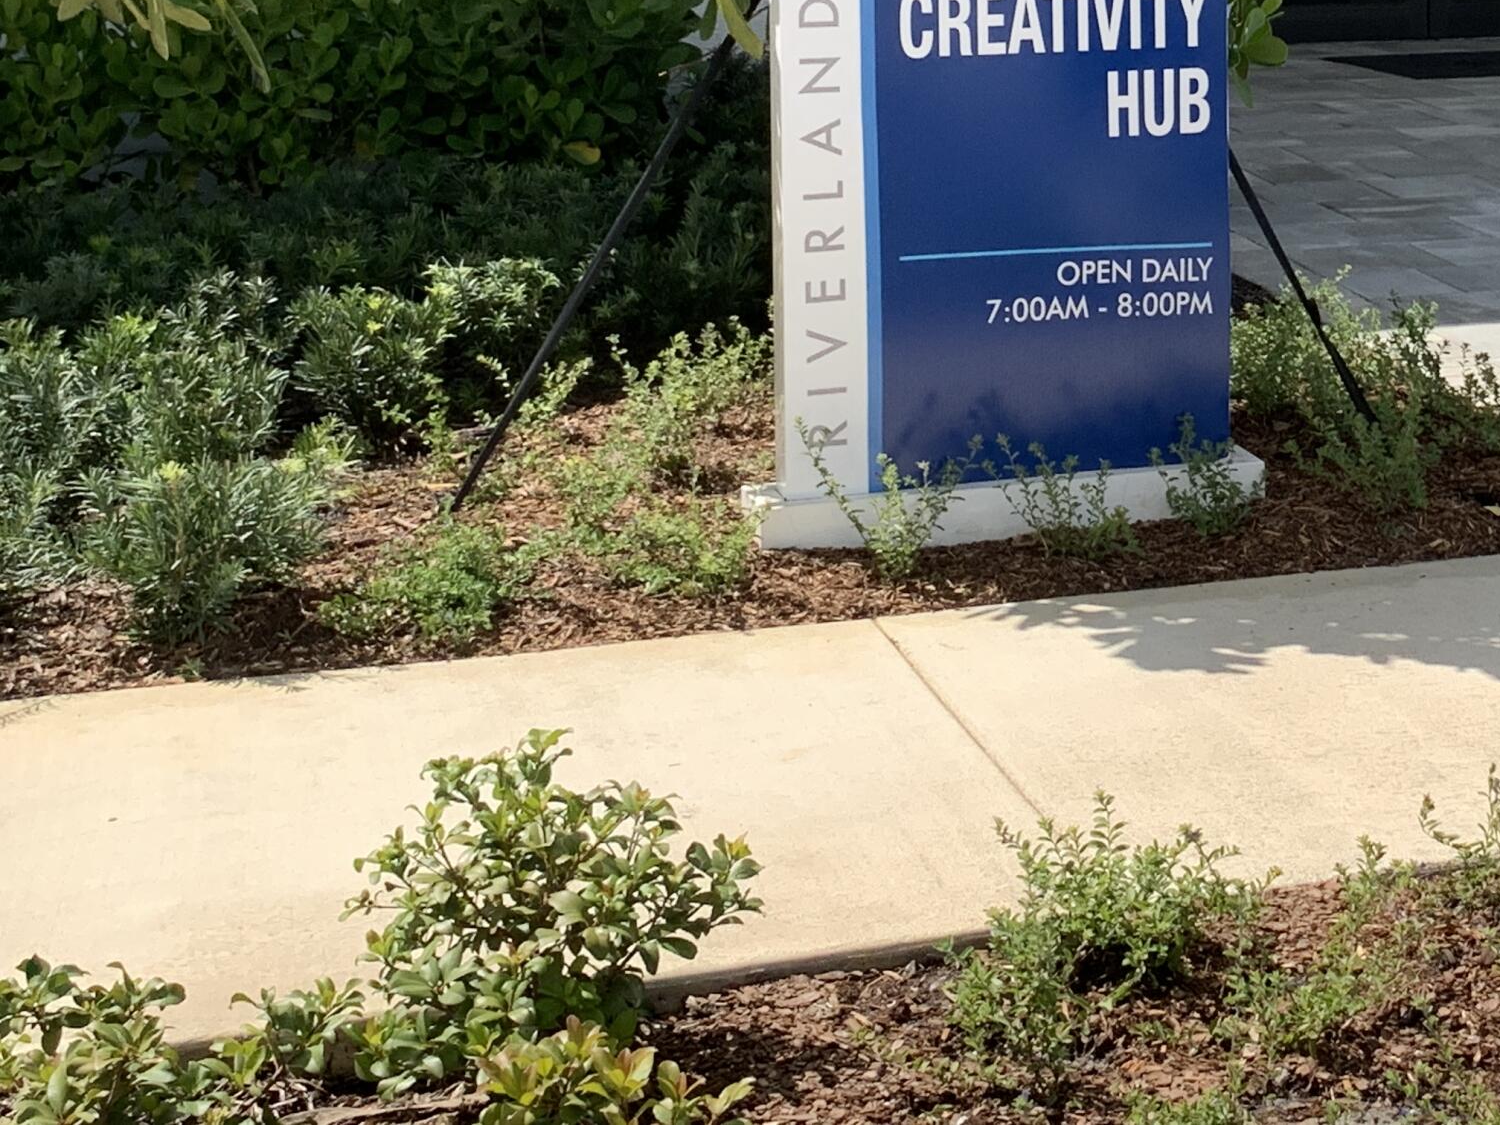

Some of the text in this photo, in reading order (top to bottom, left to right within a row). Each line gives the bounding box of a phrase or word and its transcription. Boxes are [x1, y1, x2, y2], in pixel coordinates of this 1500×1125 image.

[1107, 66, 1212, 138] HUB
[1056, 256, 1214, 287] OPEN DAILY
[985, 295, 1091, 324] 7:00AM
[1116, 291, 1214, 318] 8:00PM
